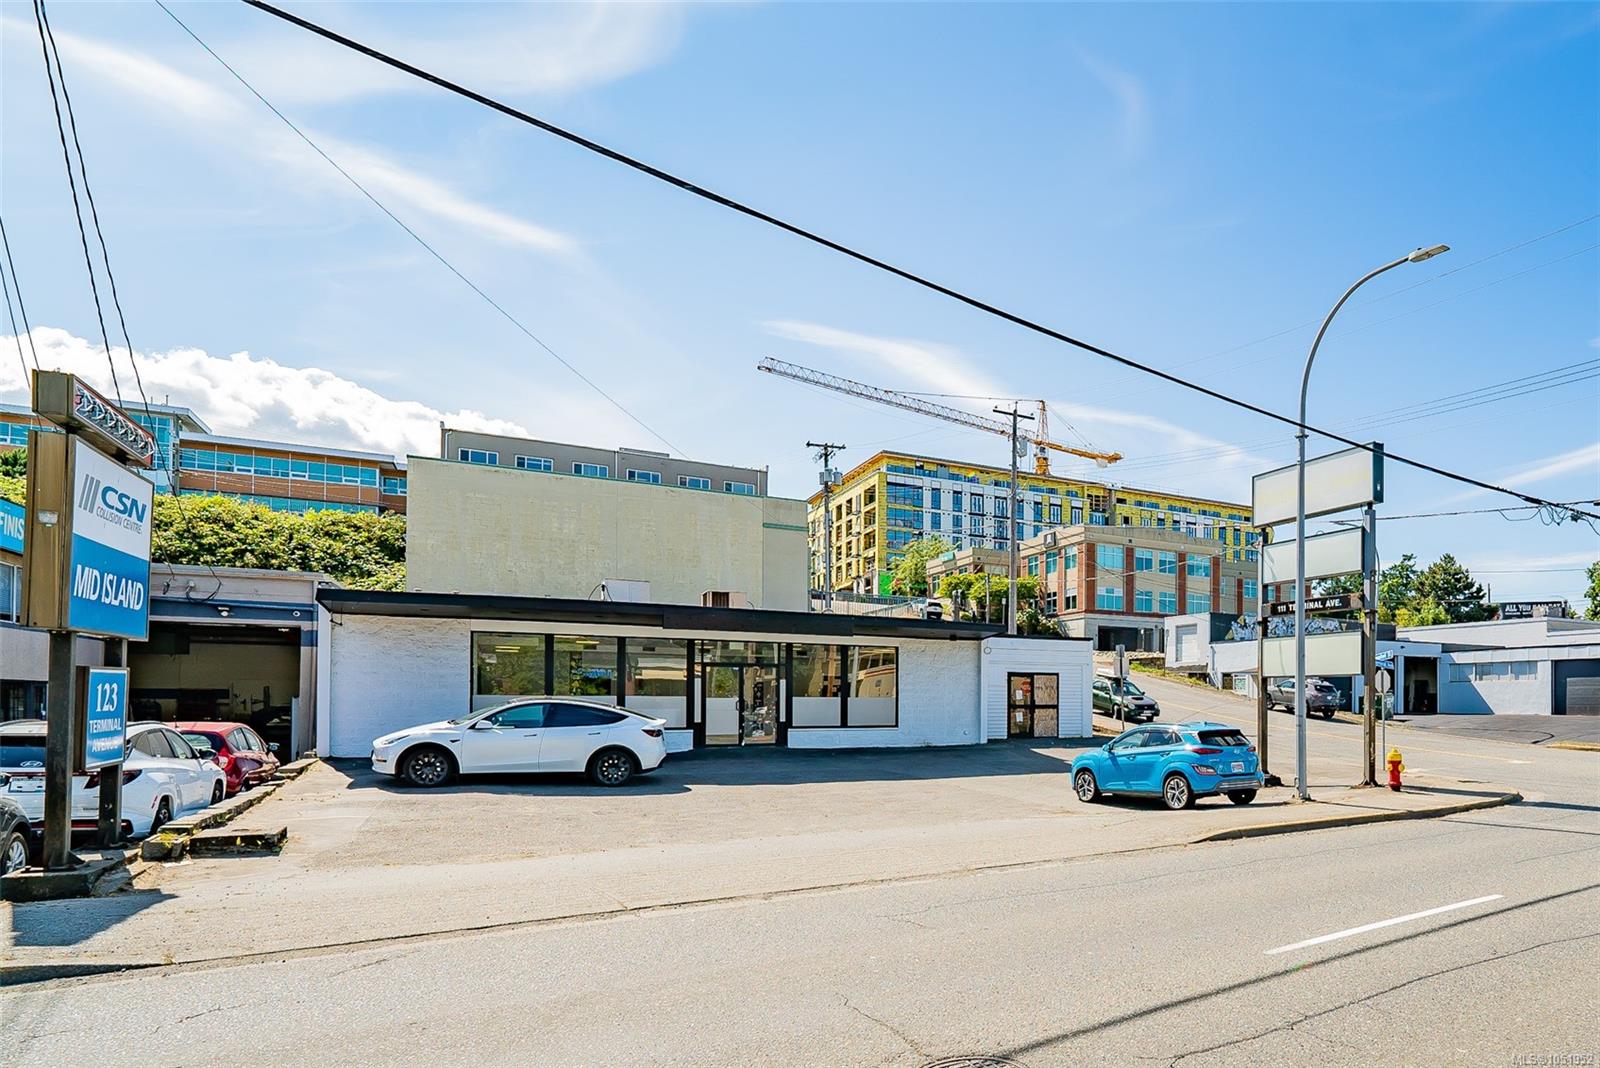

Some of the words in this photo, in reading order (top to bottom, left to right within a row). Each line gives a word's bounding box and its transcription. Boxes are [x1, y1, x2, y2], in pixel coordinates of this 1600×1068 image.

[101, 485, 147, 523] CSN
[96, 505, 123, 527] COLLISION
[122, 516, 142, 535] CENTRE
[73, 564, 99, 601] MID
[101, 572, 144, 611] ISLAND
[1325, 599, 1342, 607] AVE.
[1505, 604, 1518, 612] ALL
[96, 682, 119, 712] 123
[89, 718, 122, 734] TERMINAL
[92, 737, 119, 753] AVENU
